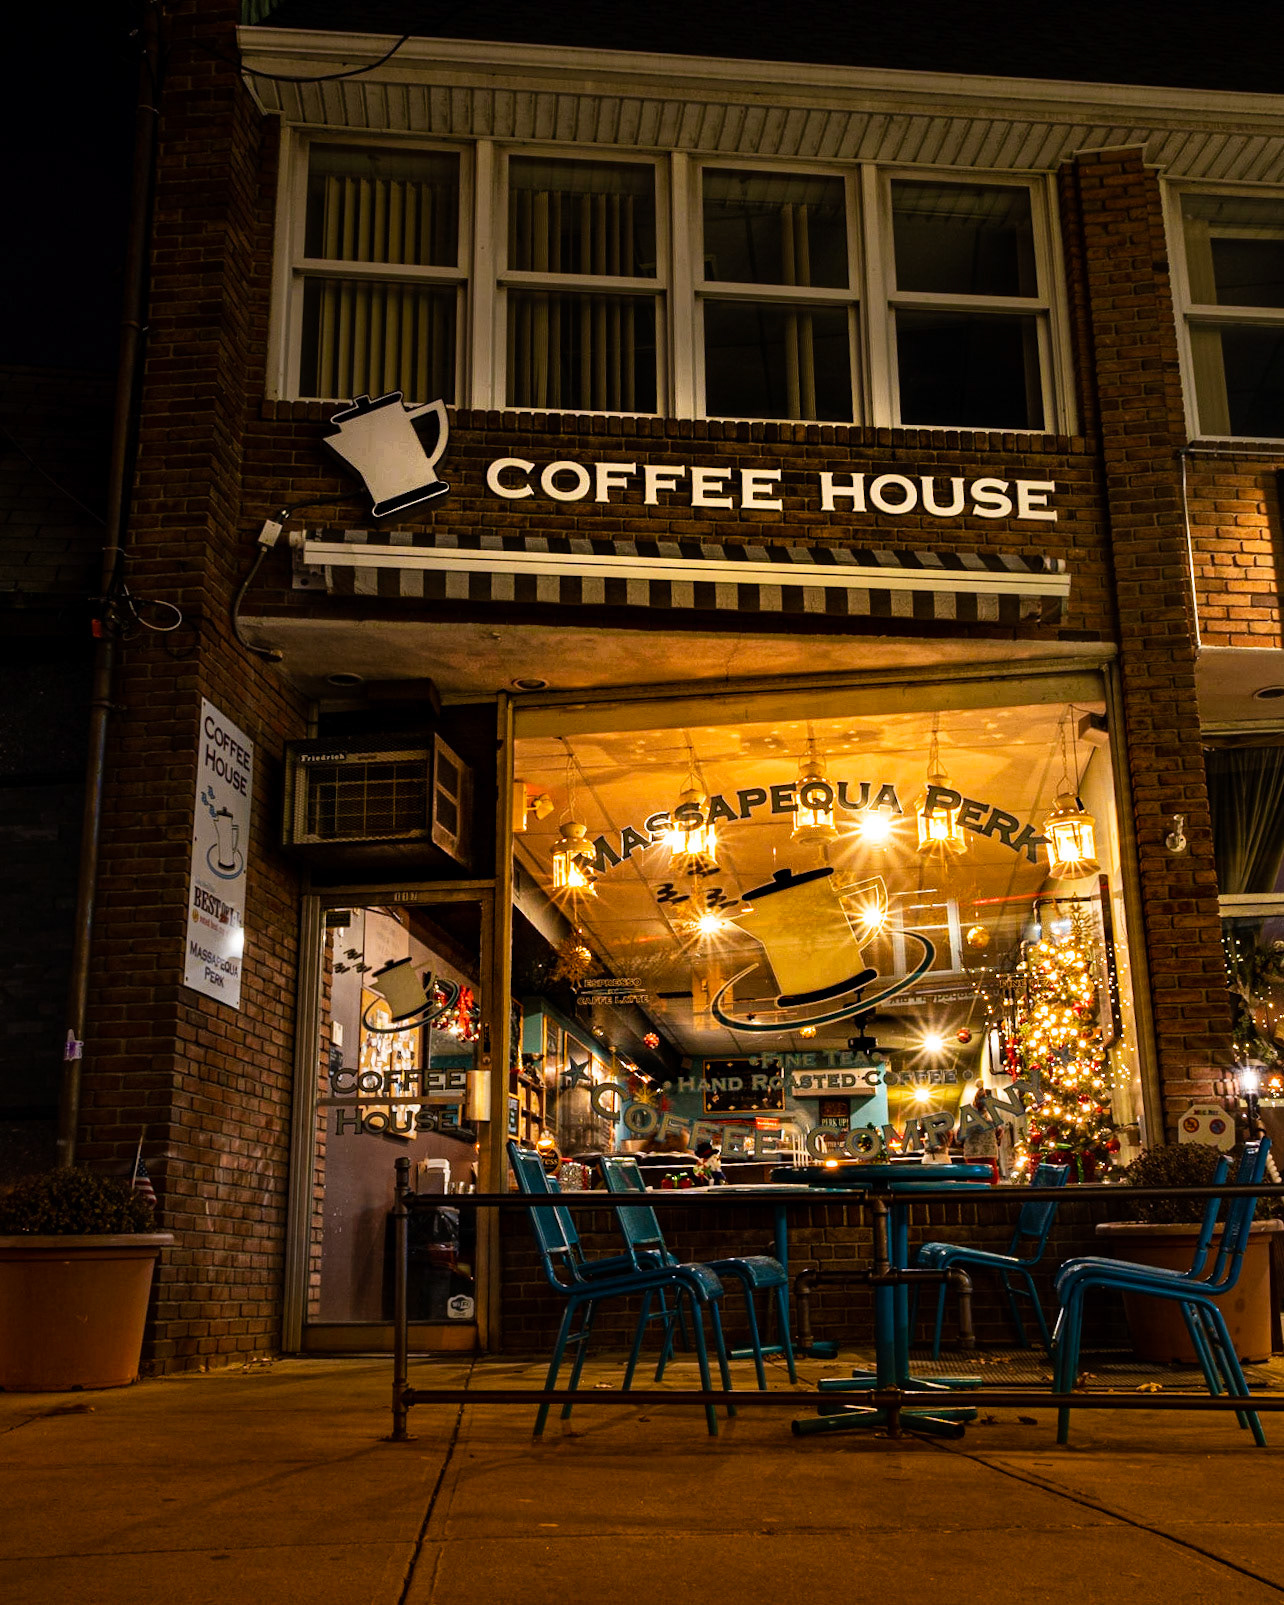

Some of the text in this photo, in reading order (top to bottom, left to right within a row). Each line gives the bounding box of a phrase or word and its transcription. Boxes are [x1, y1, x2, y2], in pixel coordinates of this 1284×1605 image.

[486, 457, 1058, 522] COFFEE HOUSE
[204, 715, 250, 772] COFFEE
[301, 753, 345, 762] Friedrich
[205, 743, 248, 797] HOUSE
[571, 781, 1053, 882] MASSAPEQUA PERK
[193, 885, 221, 919] BEST
[189, 940, 239, 978] MASSAPEQUA
[204, 966, 224, 988] PERK
[583, 977, 642, 988] ESPRESSO
[761, 1050, 869, 1069] FINE TEA
[330, 1068, 467, 1094] COFFEE
[677, 1068, 958, 1094] HAND ROASTED COFFEE
[335, 1108, 460, 1135] HOUSE
[590, 1067, 1048, 1163] COFFEE COMPANY
